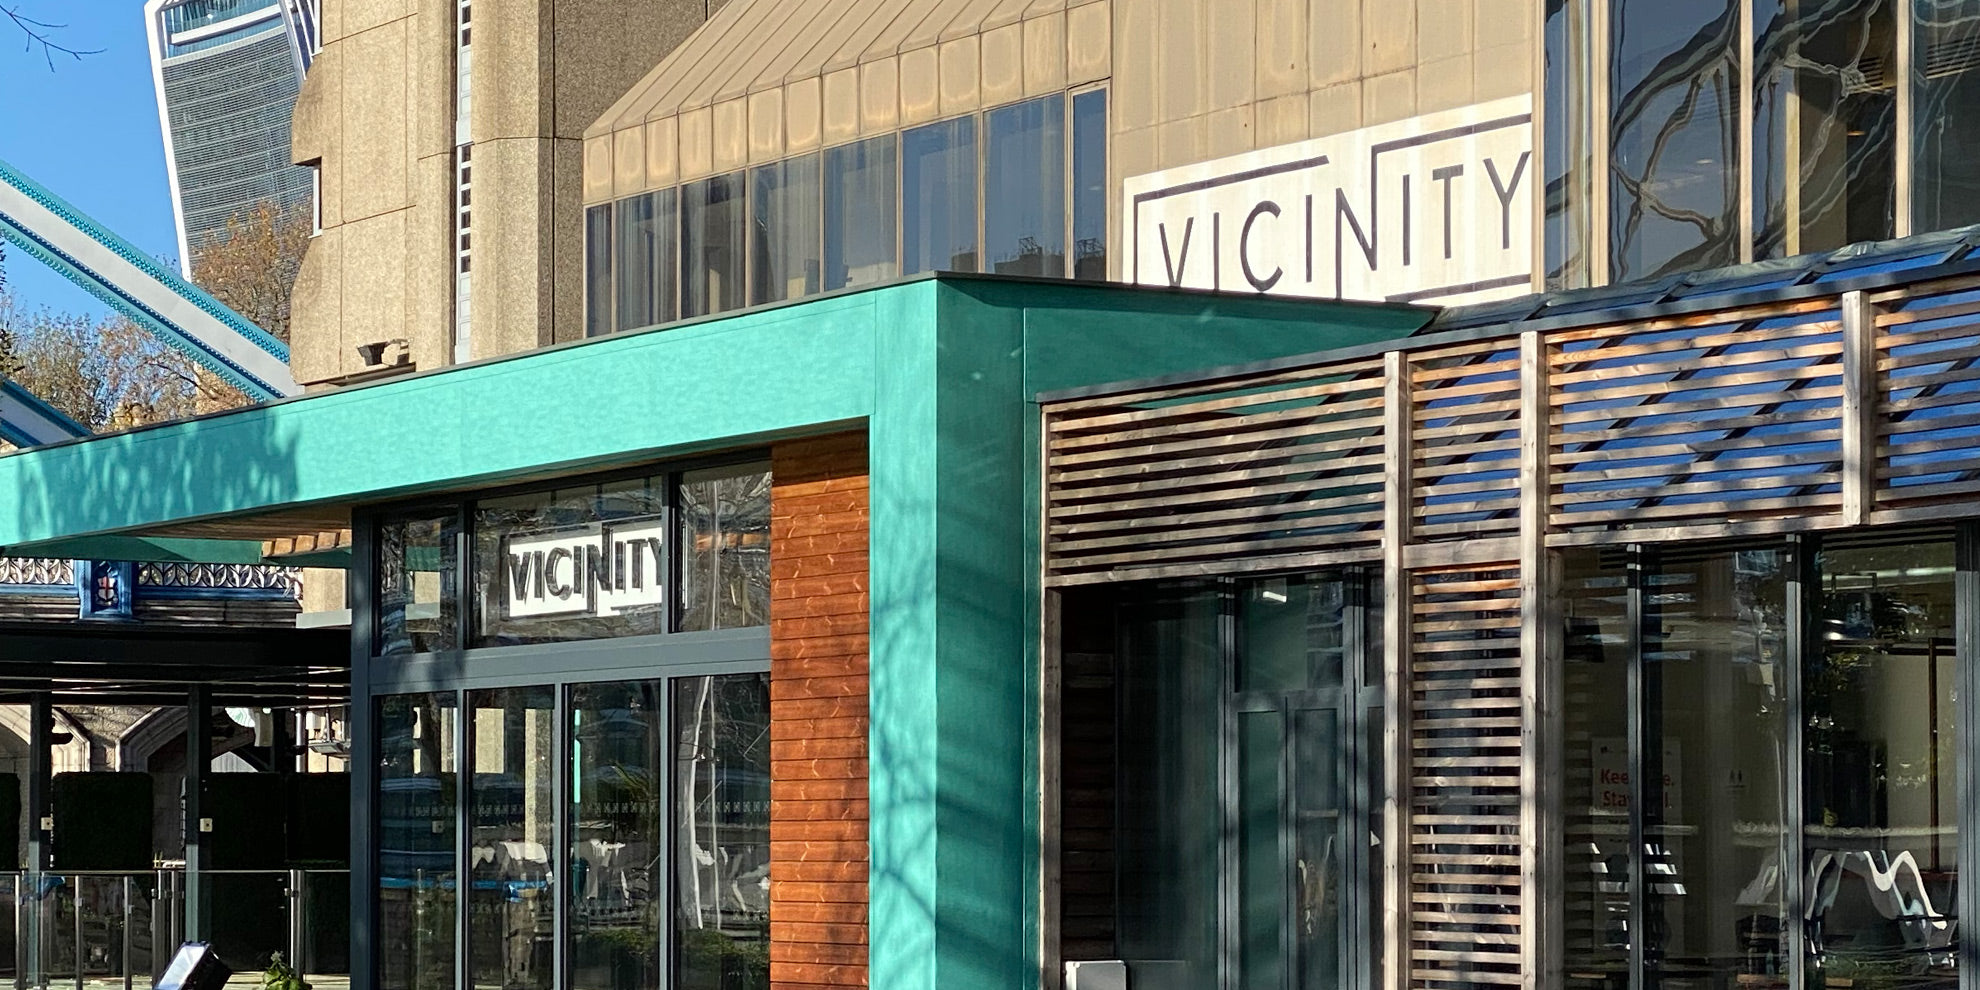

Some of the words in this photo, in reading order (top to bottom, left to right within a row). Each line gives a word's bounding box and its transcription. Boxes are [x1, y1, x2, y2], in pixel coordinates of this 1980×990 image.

[1159, 146, 1531, 299] VICINITY
[1601, 769, 1629, 785] Kee
[1603, 791, 1629, 807] Sta
